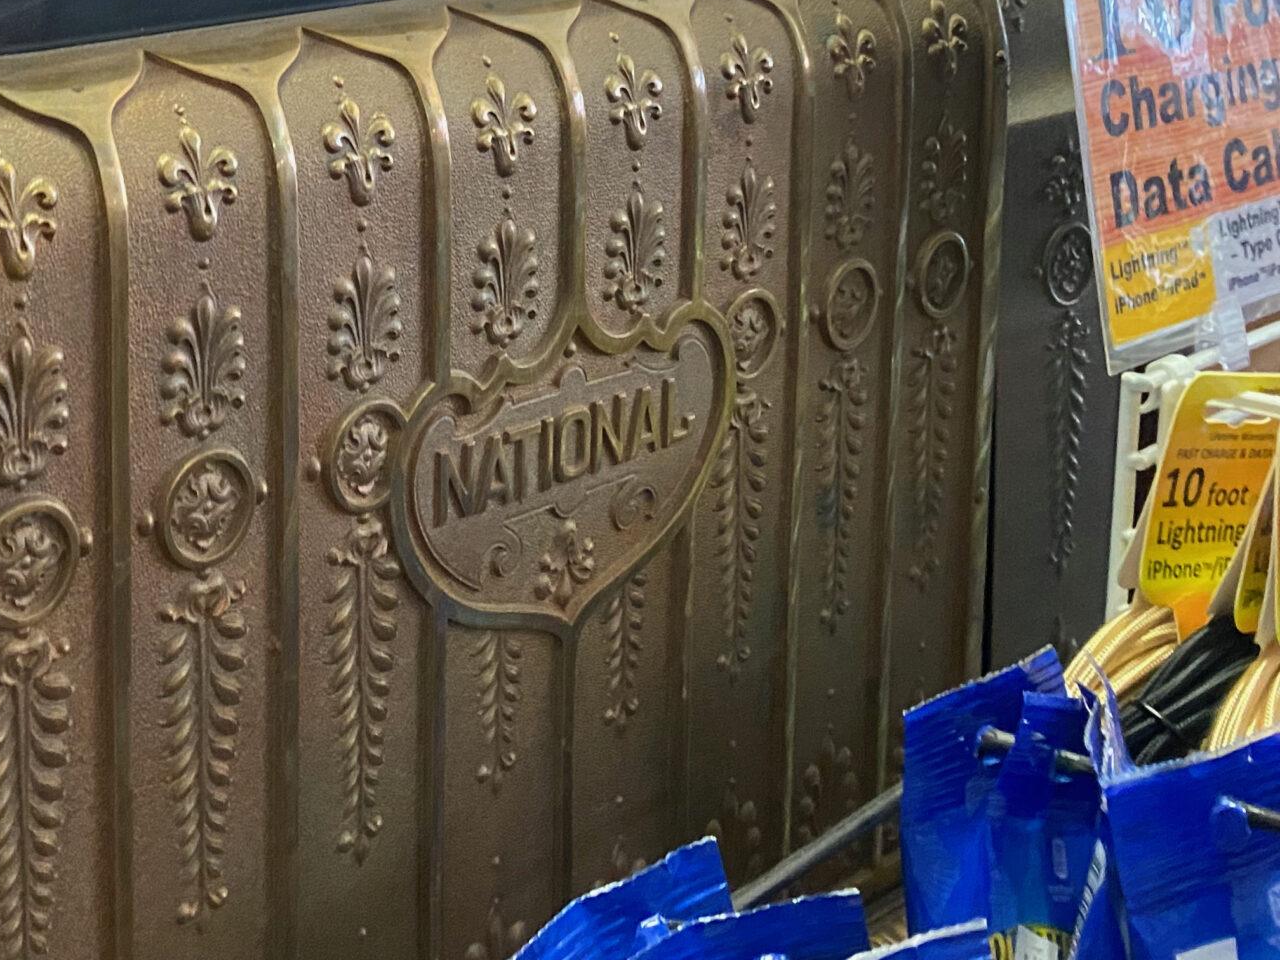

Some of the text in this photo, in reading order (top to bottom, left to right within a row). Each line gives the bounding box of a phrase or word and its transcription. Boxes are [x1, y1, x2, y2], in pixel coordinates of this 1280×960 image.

[1100, 57, 1280, 137] Charging
[1110, 158, 1211, 229] Data
[433, 378, 695, 527] NATIONAL
[1162, 467, 1249, 508] 10 foot
[1156, 519, 1247, 551] Lightning
